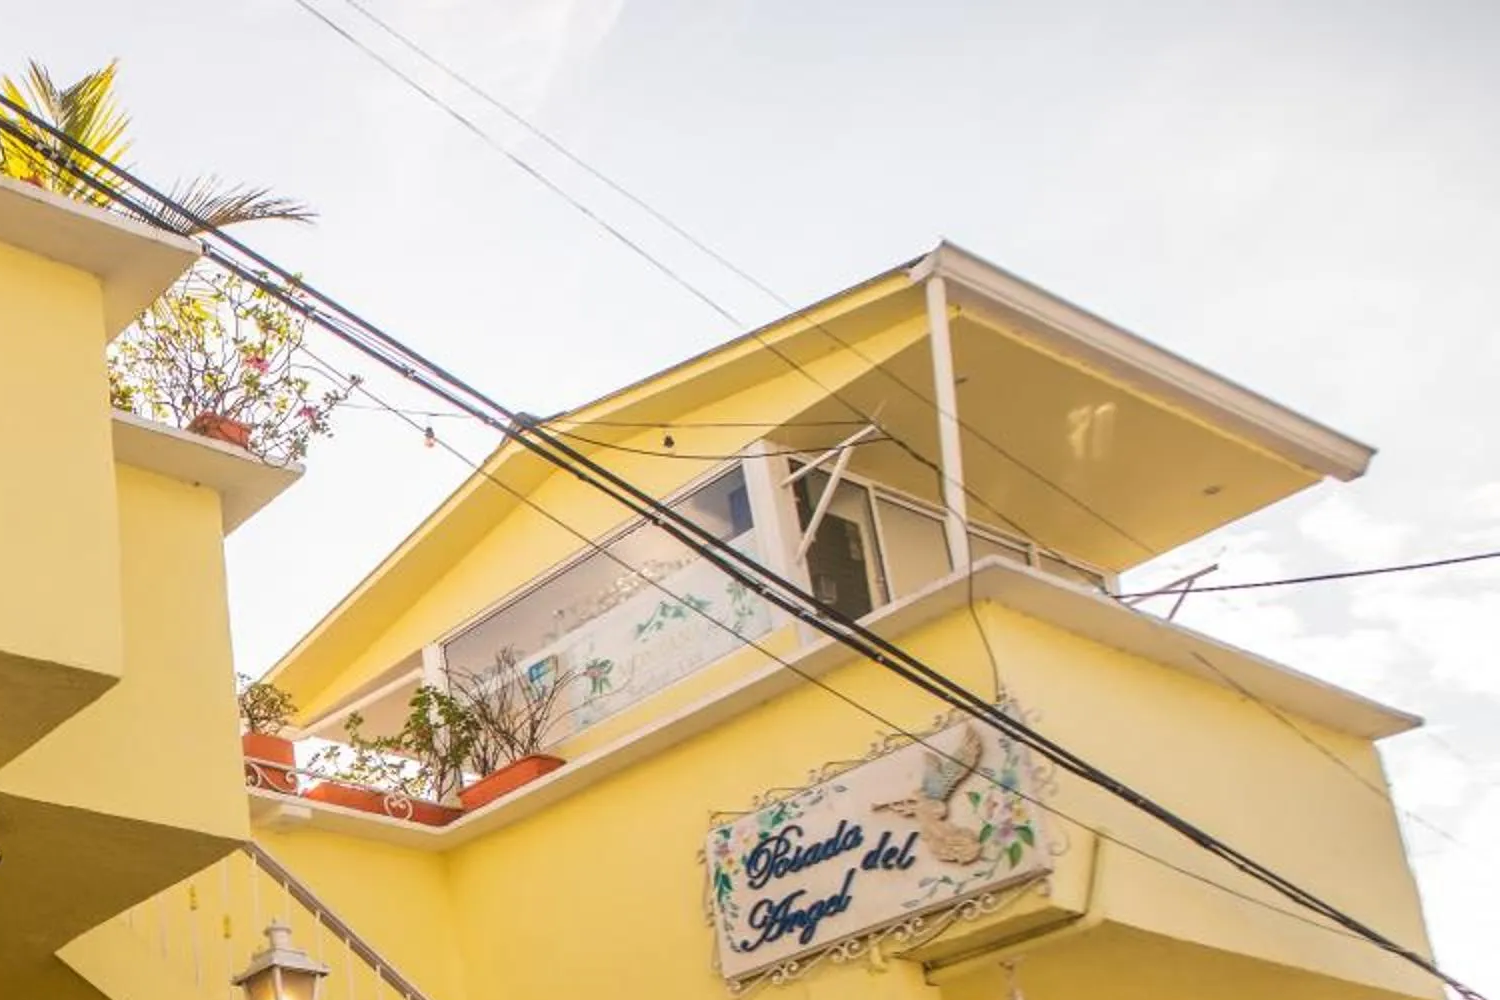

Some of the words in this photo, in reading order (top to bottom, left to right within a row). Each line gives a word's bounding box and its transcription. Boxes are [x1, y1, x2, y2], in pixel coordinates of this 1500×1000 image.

[745, 820, 863, 889] Posada
[861, 831, 920, 871] del
[740, 868, 857, 951] Angel
